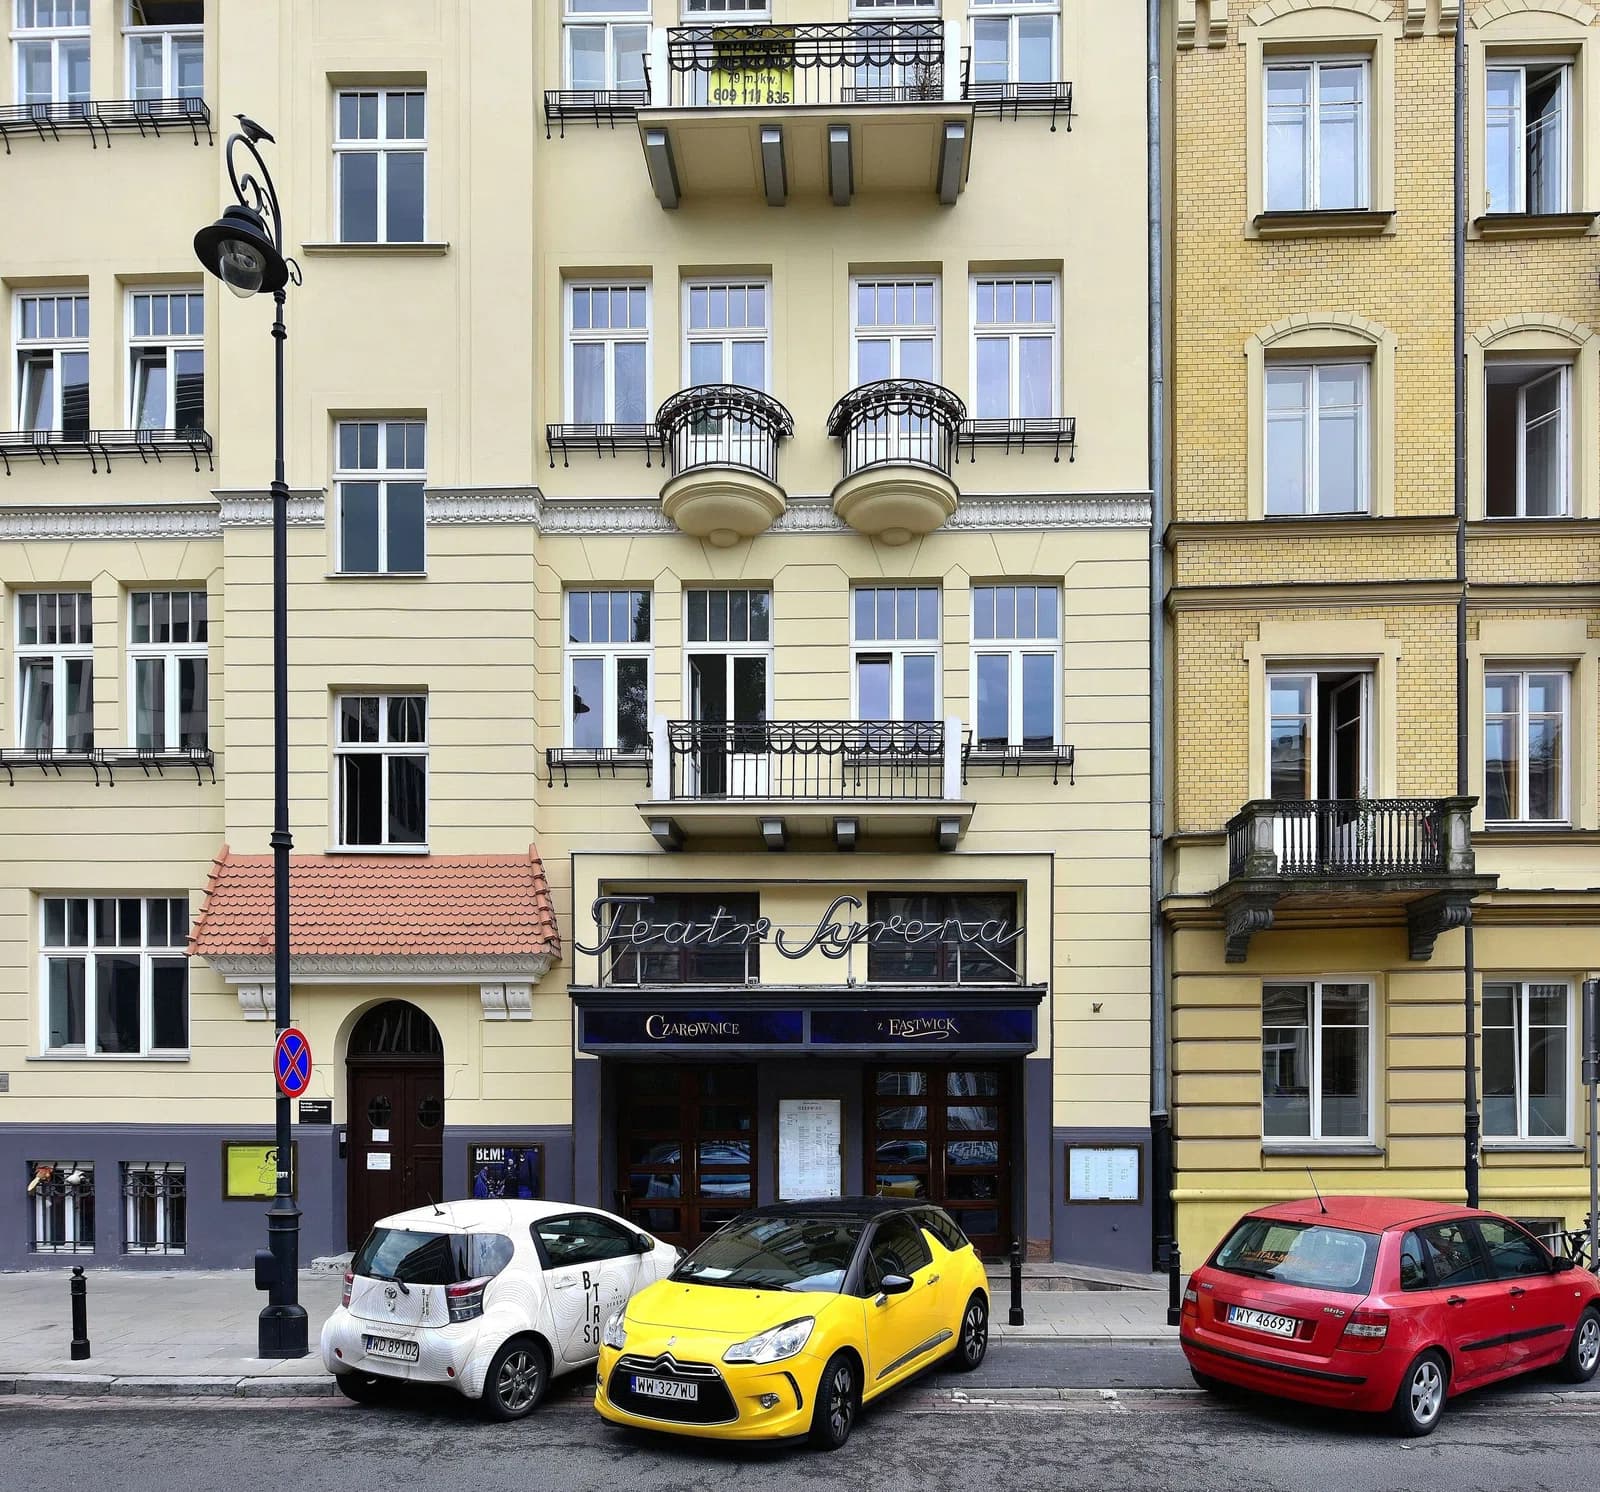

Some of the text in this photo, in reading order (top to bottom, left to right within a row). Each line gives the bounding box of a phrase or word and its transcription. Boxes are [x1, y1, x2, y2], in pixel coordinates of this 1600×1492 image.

[728, 72, 740, 83] 79
[713, 88, 790, 104] 609 111 835
[575, 895, 1025, 959] Teatr Syrena
[476, 1148, 505, 1161] BEM!
[1236, 1307, 1293, 1332] WY 46693
[373, 1337, 386, 1351] WD
[388, 1340, 418, 1357] 89102
[637, 1377, 696, 1399] WW 327WU
